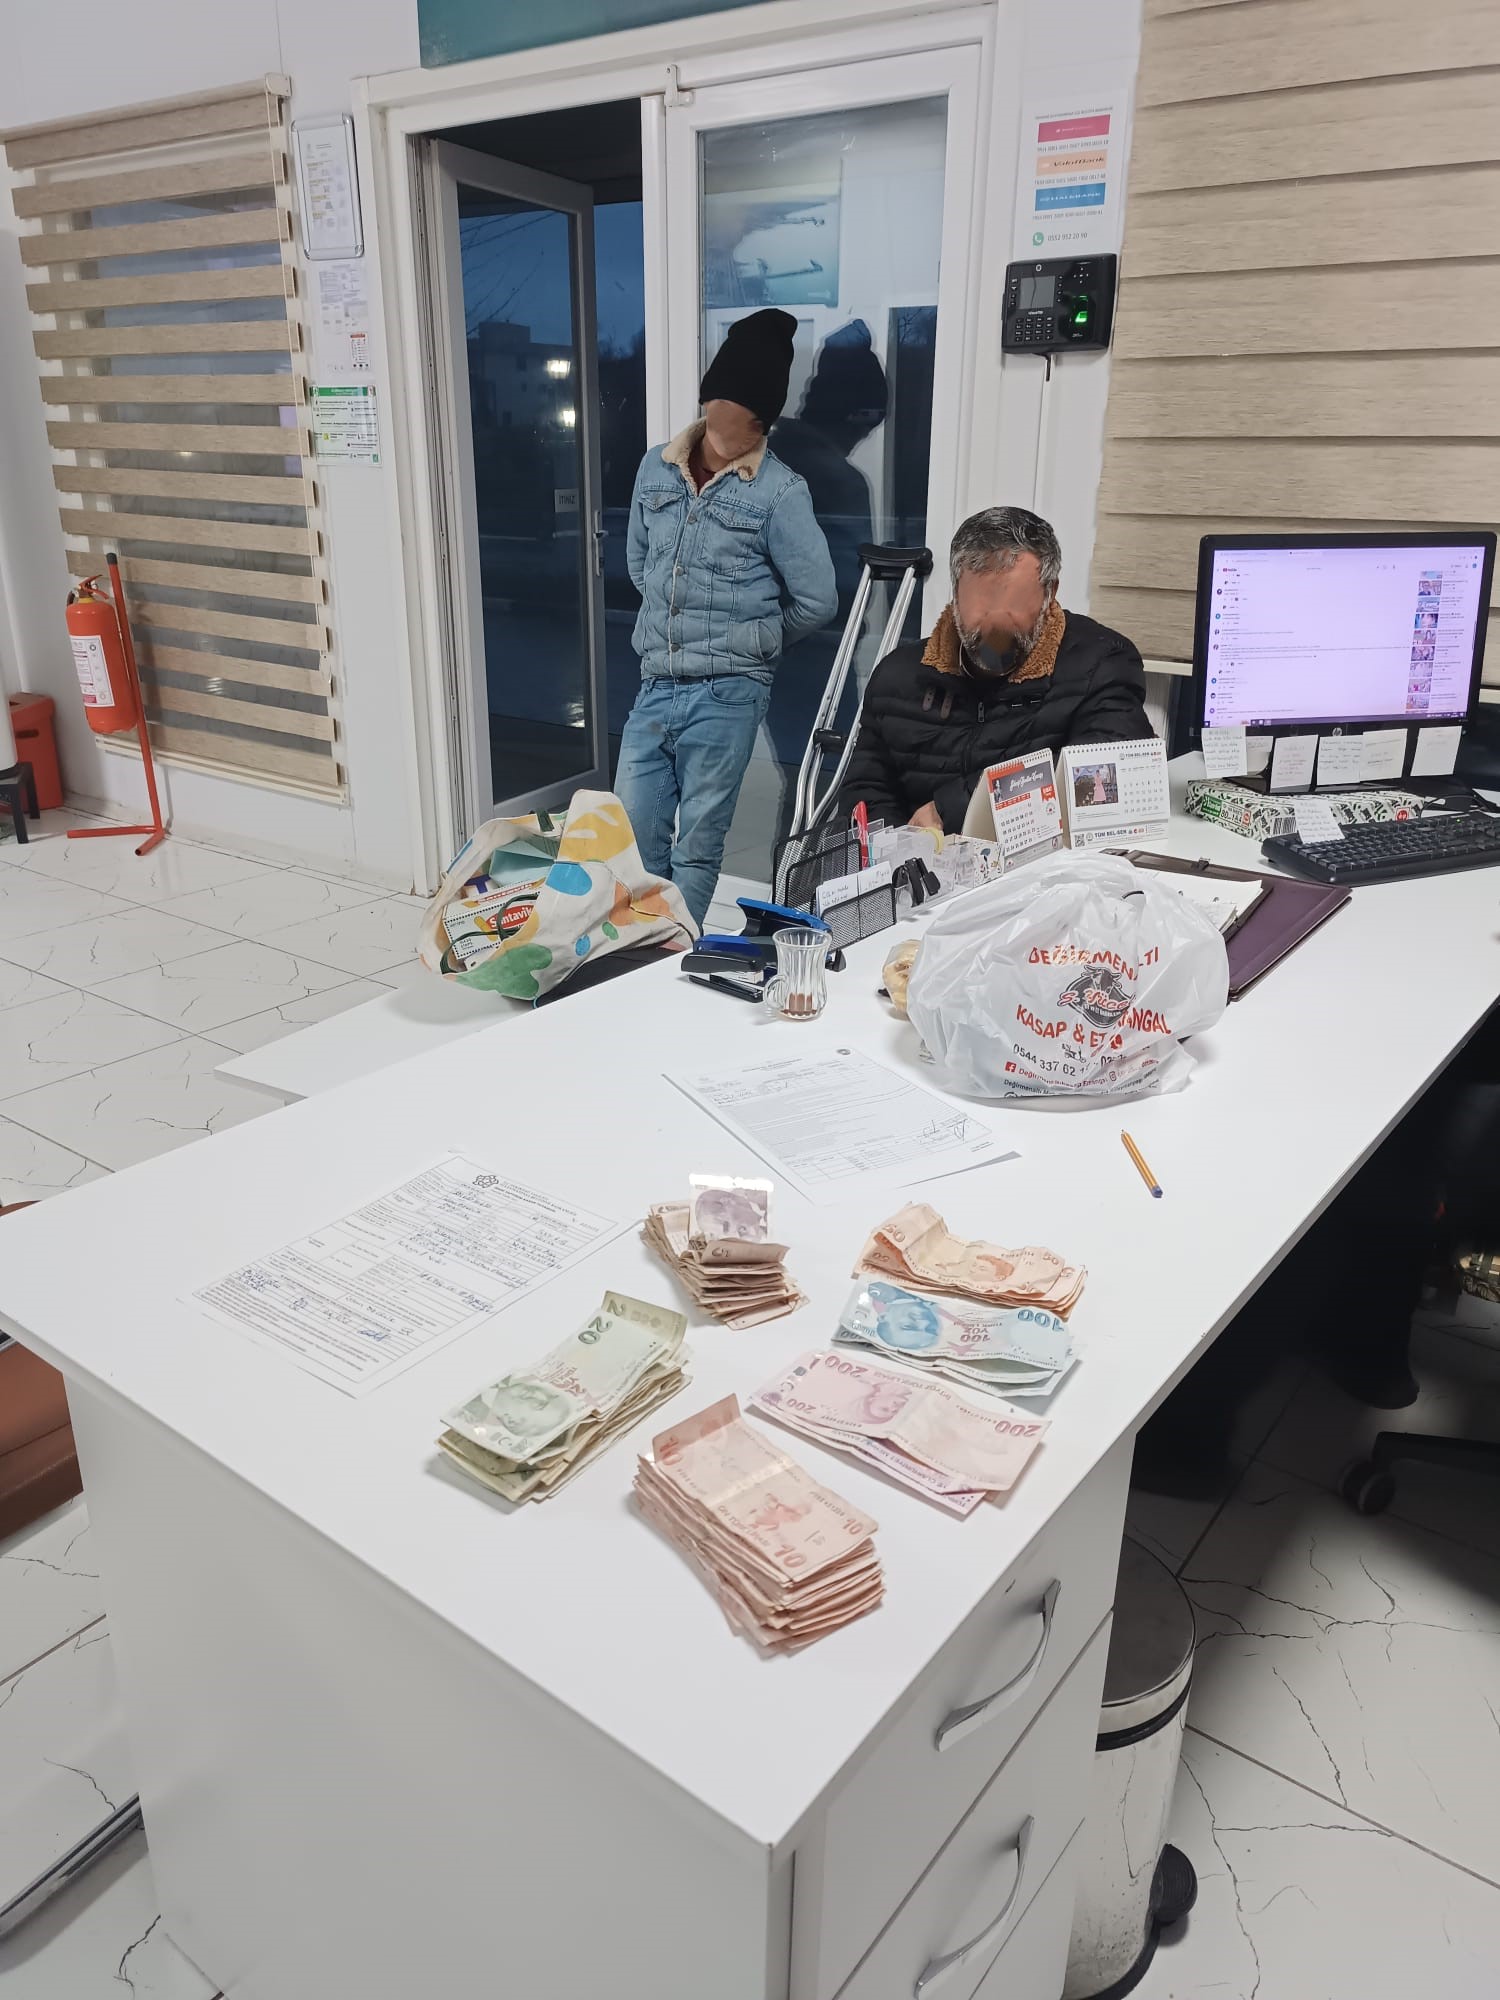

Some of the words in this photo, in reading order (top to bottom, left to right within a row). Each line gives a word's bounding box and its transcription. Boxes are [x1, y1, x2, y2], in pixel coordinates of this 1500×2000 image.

[489, 907, 534, 927] Sntavik
[1016, 1004, 1067, 1039] KASAP
[1073, 1023, 1085, 1045] &
[1013, 1043, 1037, 1064] 0544
[1039, 1060, 1060, 1072] 337
[1062, 1064, 1076, 1077] 62
[578, 1316, 613, 1344] 20
[1018, 1309, 1065, 1331] 100
[960, 1335, 991, 1344] 100
[825, 1355, 869, 1378] 200
[787, 1398, 817, 1414] 200
[994, 1420, 1042, 1438] 200
[842, 1518, 864, 1536] 10
[774, 1544, 807, 1568] 10
